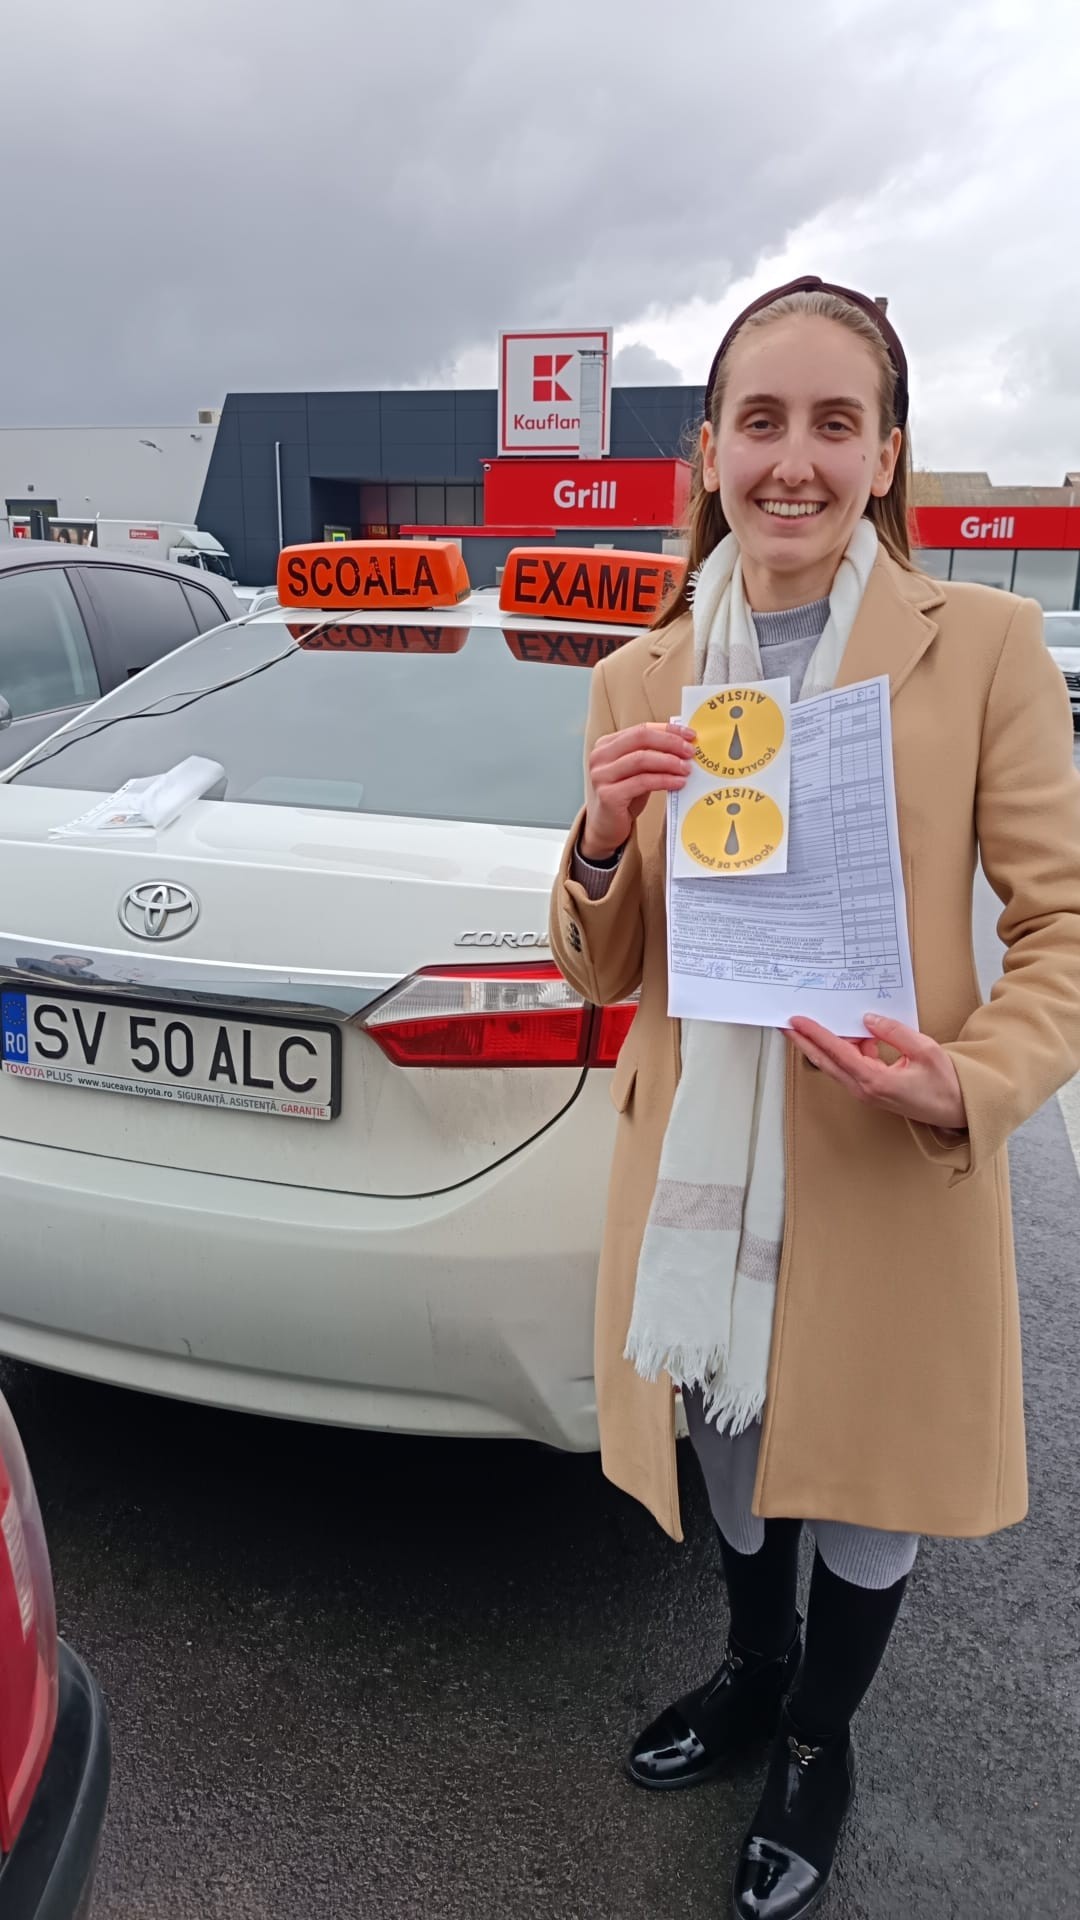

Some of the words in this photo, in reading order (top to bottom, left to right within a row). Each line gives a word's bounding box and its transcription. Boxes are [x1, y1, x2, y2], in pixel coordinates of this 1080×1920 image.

[513, 413, 580, 430] Kauflan
[553, 479, 617, 509] Grill
[960, 516, 1015, 539] Grill
[287, 555, 439, 597] SCOALA
[707, 690, 767, 710] ALISTAR
[695, 746, 720, 772] ȘOFER
[721, 767, 735, 775] DE
[703, 788, 766, 806] ALISTAR
[717, 861, 730, 869] DE
[454, 931, 549, 948] COROL
[5, 1031, 26, 1054] RO
[33, 1004, 106, 1065] SV
[129, 1015, 194, 1077] 50
[208, 1026, 318, 1093] ALC
[4, 1062, 45, 1079] TOYOTA
[46, 1070, 73, 1083] PLUS
[78, 1077, 173, 1098] www.suceava.toyota.ro
